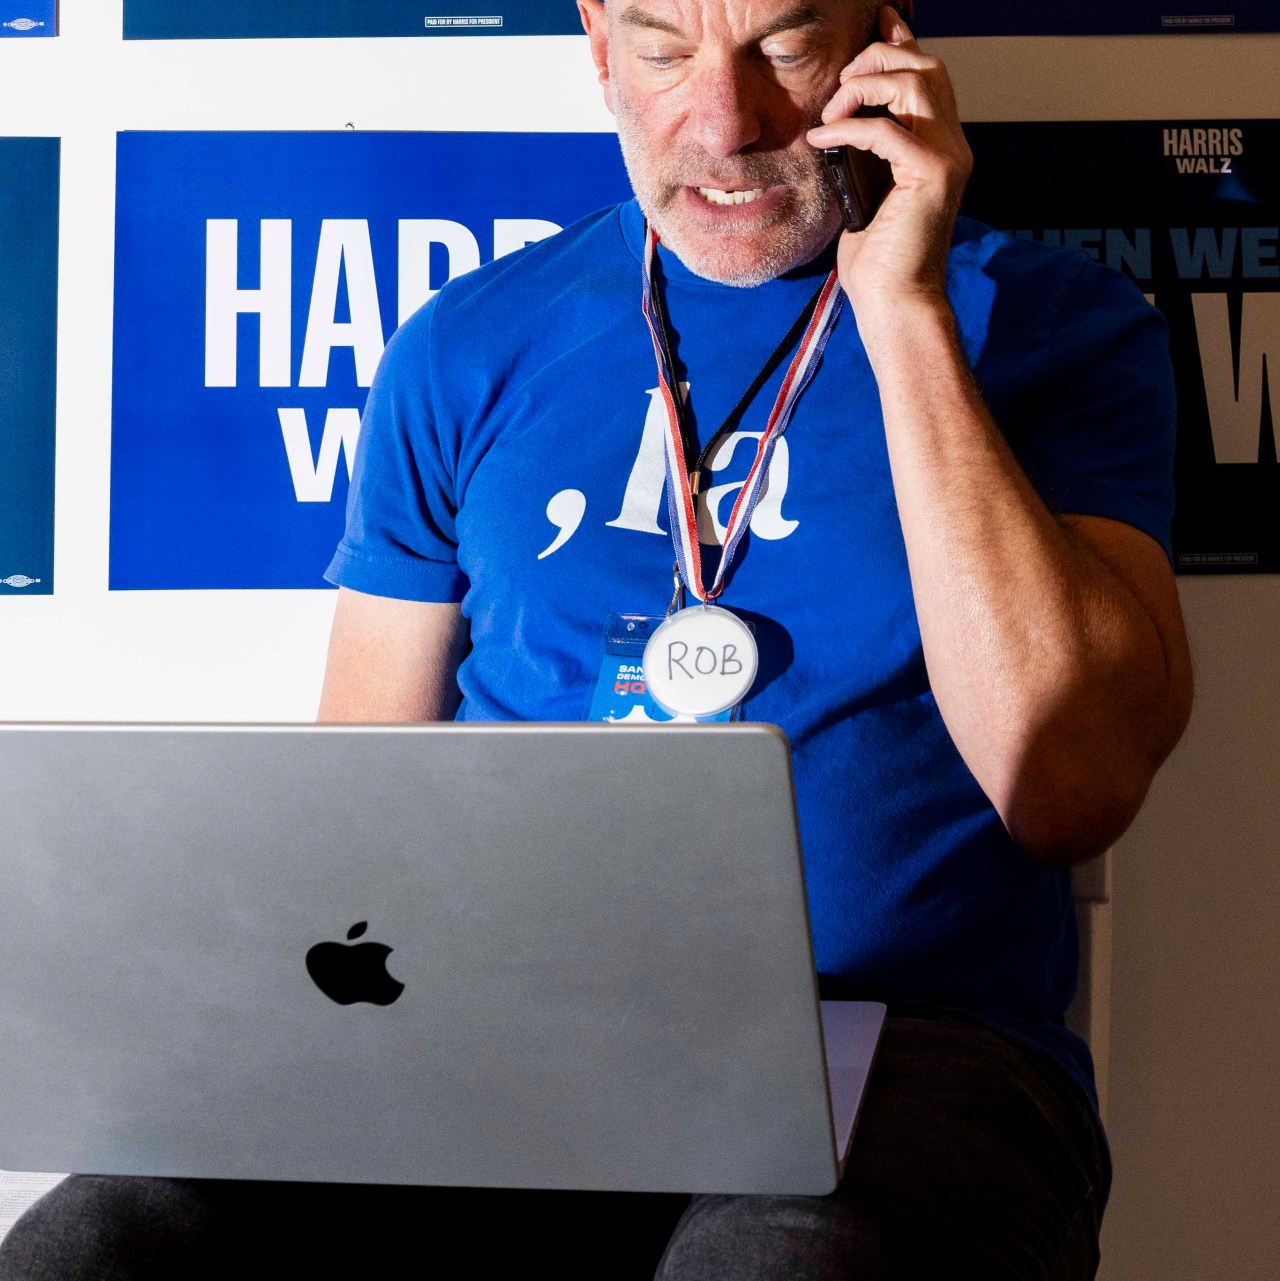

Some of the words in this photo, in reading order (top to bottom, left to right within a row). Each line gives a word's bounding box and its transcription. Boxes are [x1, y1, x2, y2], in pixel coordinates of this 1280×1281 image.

[1163, 128, 1243, 156] HARRIS
[1176, 158, 1232, 173] WALZ
[1169, 228, 1280, 279] WE
[668, 641, 743, 680] ROB
[614, 681, 646, 694] HQ
